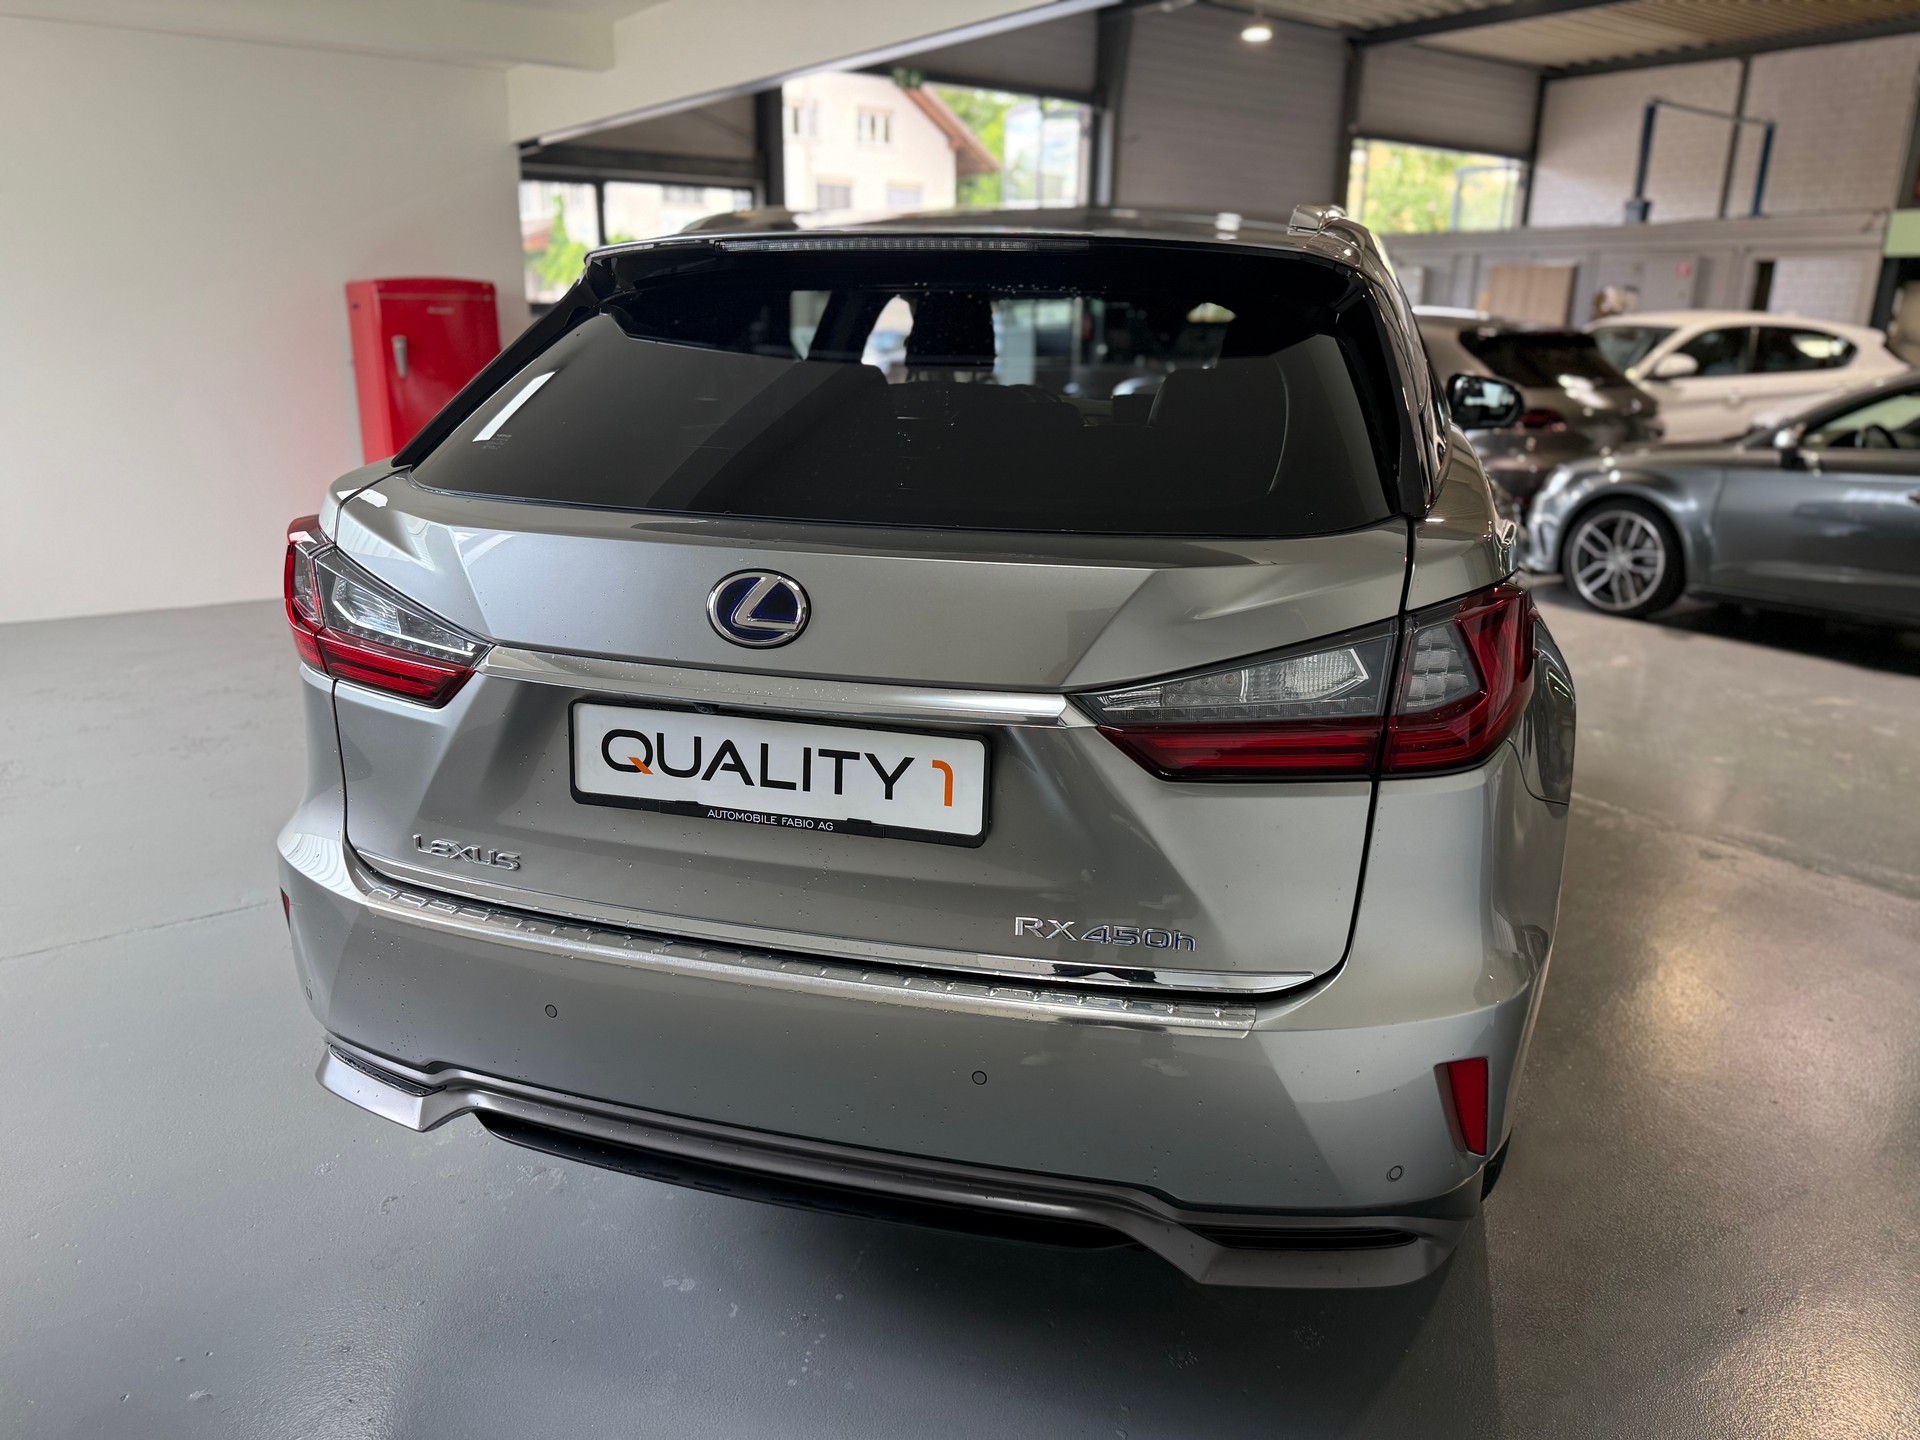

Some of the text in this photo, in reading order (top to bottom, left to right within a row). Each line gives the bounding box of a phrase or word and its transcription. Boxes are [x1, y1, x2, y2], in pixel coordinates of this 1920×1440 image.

[601, 728, 954, 807] QUALITY 1
[707, 809, 834, 831] AUTOMOBILE FABIO AG
[413, 834, 521, 871] LEXUS
[1015, 916, 1196, 952] RX 450h
